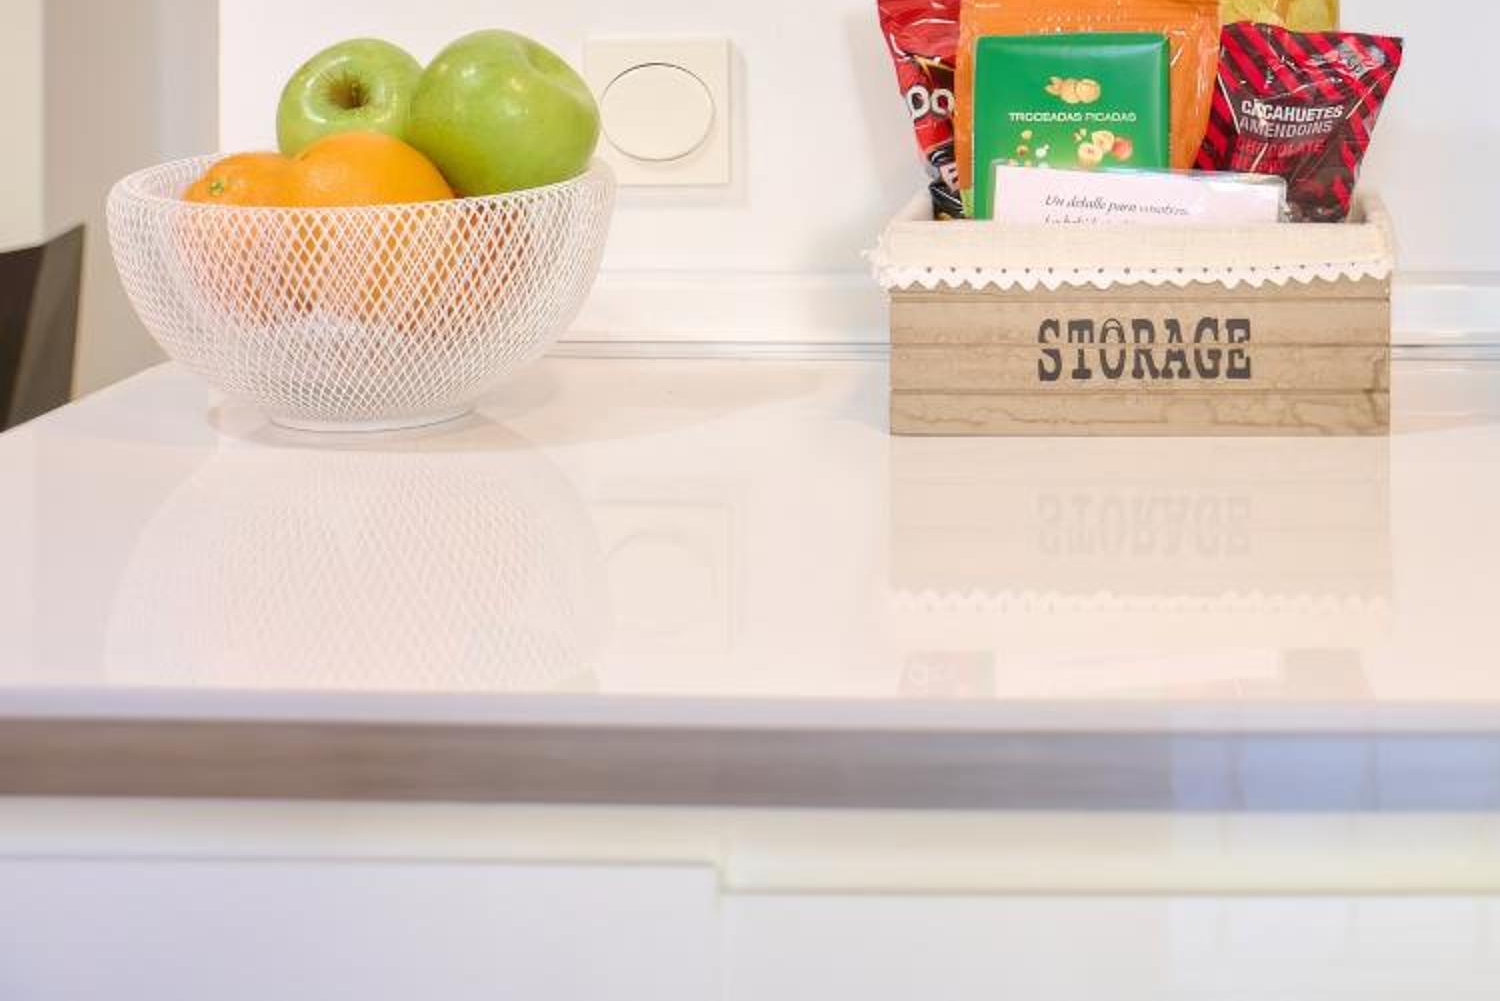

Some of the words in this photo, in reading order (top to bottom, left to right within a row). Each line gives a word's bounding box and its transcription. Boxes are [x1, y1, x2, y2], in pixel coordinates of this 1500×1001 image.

[1085, 112, 1137, 122] PICADAS
[1241, 98, 1344, 122] CACAHUETES
[1239, 116, 1333, 138] AMENDOINS
[1037, 317, 1252, 381] STORAGE
